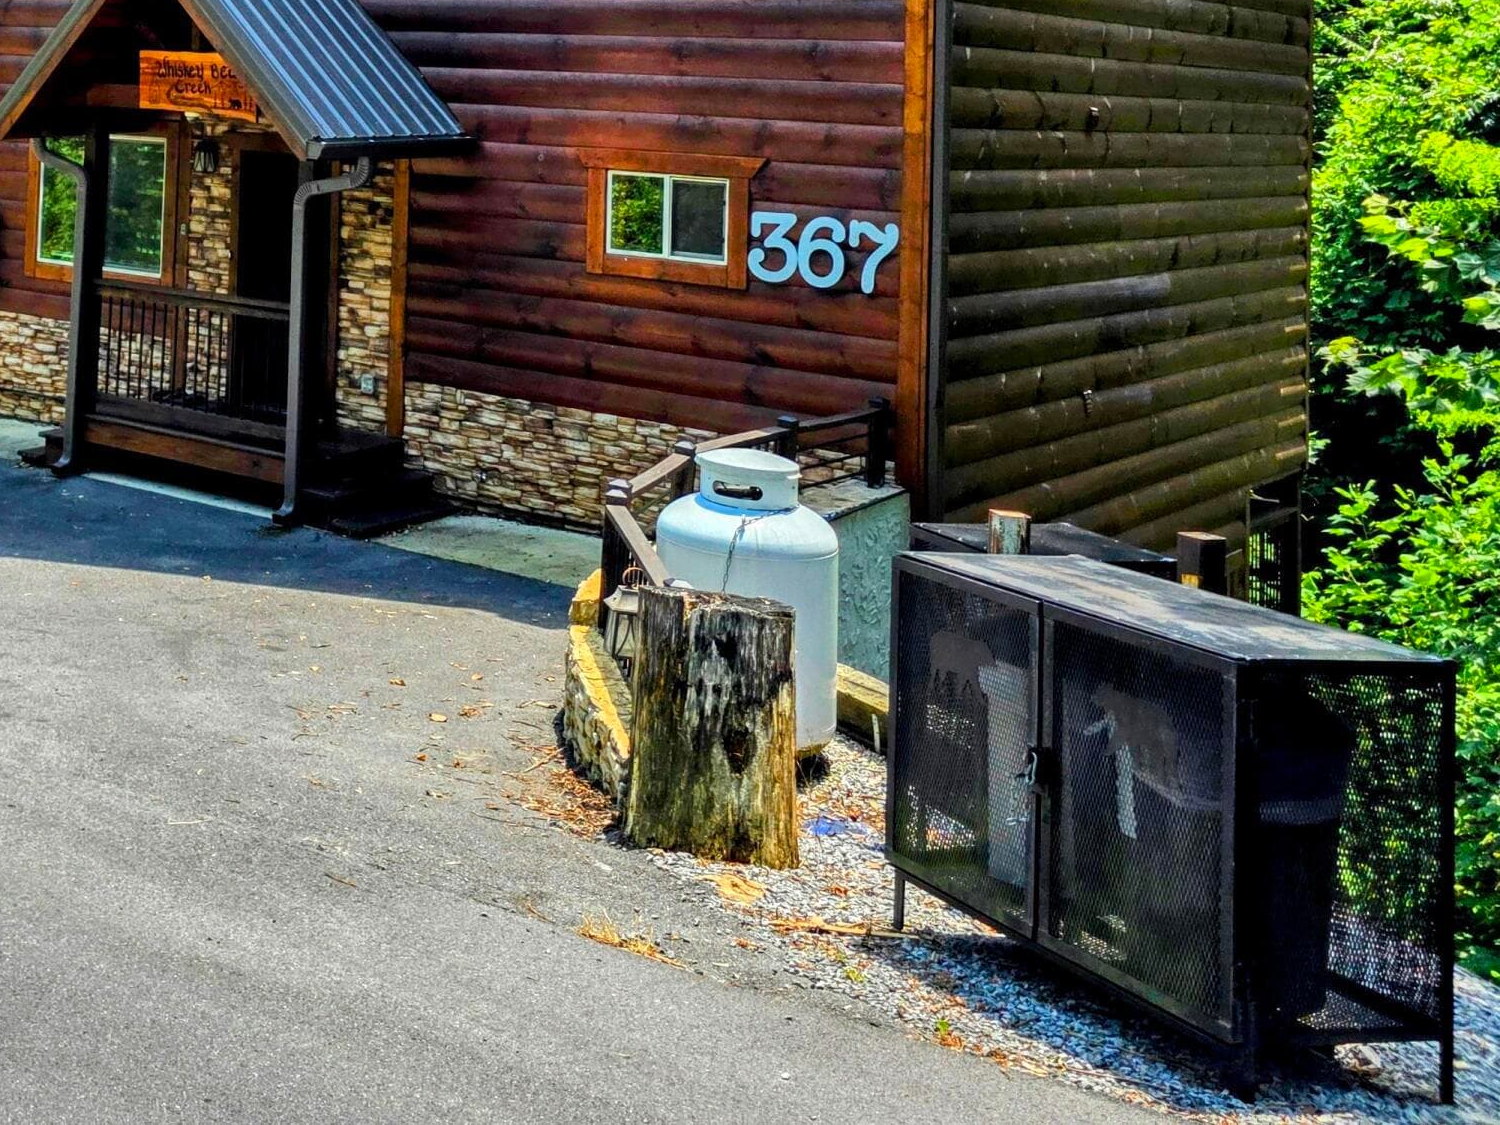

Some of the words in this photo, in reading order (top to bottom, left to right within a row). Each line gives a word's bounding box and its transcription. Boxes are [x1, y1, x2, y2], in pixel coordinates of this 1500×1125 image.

[156, 56, 204, 81] Whiskey
[210, 63, 237, 80] Bea
[748, 211, 899, 294] 367
